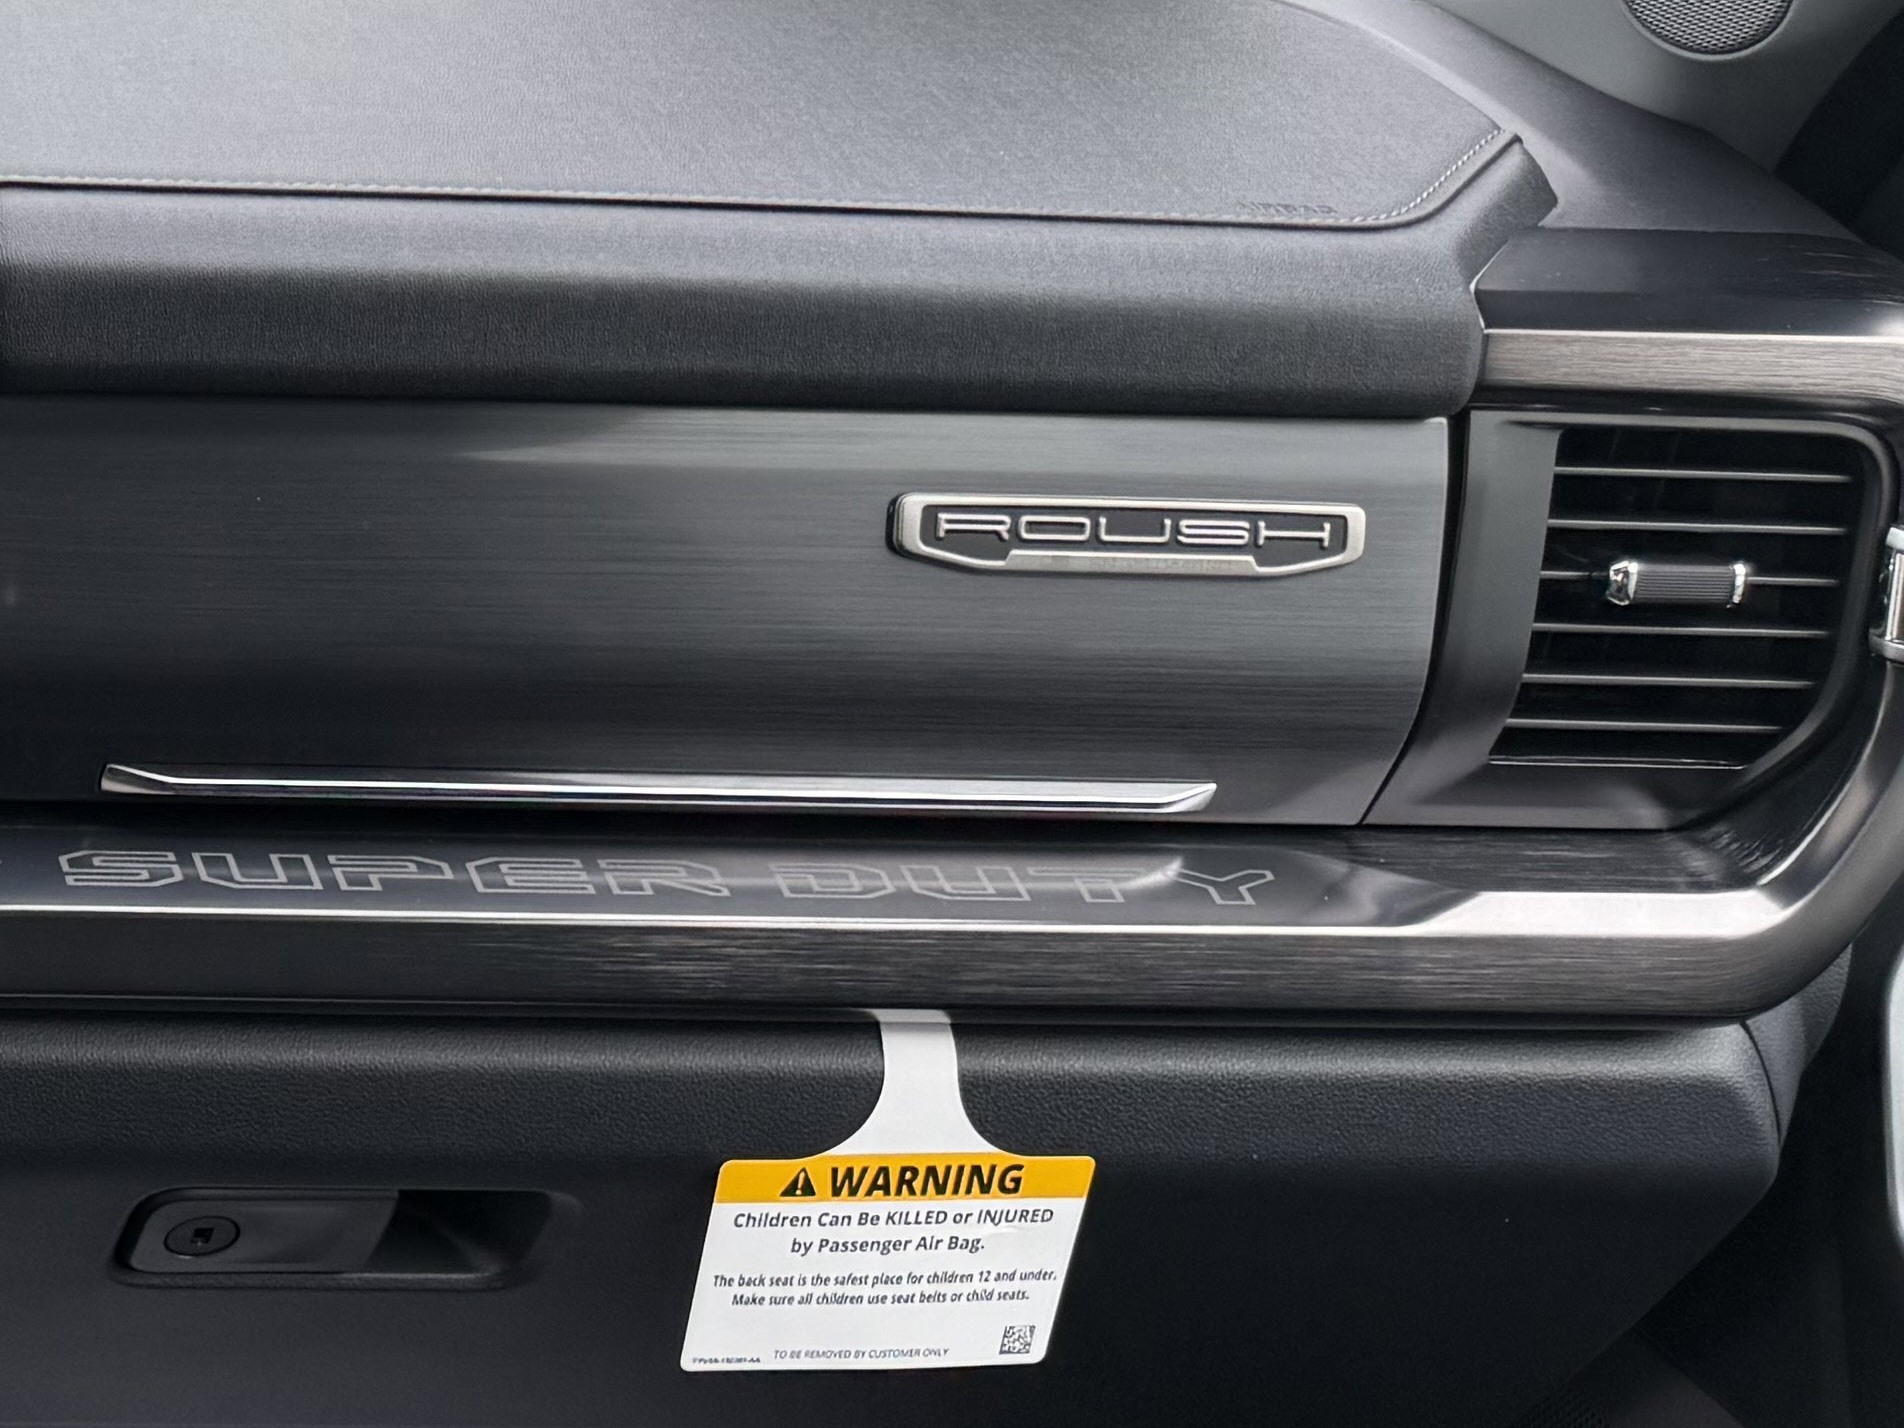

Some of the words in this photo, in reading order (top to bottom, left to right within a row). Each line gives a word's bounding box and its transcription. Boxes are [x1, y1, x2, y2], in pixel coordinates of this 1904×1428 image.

[936, 512, 1331, 549] ROUSH
[58, 849, 723, 898] SUPER
[773, 862, 1277, 908] DUTY
[829, 1163, 1025, 1198] WARNING
[734, 1210, 812, 1229] Children
[817, 1211, 852, 1228] Can
[857, 1211, 880, 1227] Be
[885, 1209, 948, 1226] KILLED
[953, 1211, 974, 1225] or
[977, 1207, 1055, 1226] INJURED
[791, 1237, 813, 1257] by
[818, 1236, 912, 1257] Passenger
[915, 1235, 944, 1251] Air
[947, 1235, 986, 1254] Bag.
[713, 1274, 734, 1287] The
[738, 1273, 765, 1287] back
[769, 1274, 794, 1287] seat
[797, 1273, 807, 1287] is
[810, 1273, 831, 1286] the
[833, 1272, 869, 1287] safest
[871, 1271, 903, 1288] place
[906, 1271, 924, 1285] for
[927, 1270, 974, 1284] children
[978, 1270, 992, 1282] 12
[994, 1269, 1016, 1282] and
[1019, 1268, 1057, 1282] under.
[732, 1293, 765, 1306] Make
[768, 1294, 794, 1306] sure
[797, 1292, 813, 1305] all
[816, 1292, 864, 1305] children
[867, 1294, 888, 1305] use
[891, 1292, 915, 1304] seat
[919, 1290, 947, 1304] belts
[950, 1292, 963, 1302] or
[966, 1288, 994, 1302] child
[997, 1289, 1030, 1301] seats.
[774, 1349, 788, 1360] TO
[804, 1348, 852, 1359] REMOVED
[868, 1348, 921, 1359] CUSTOMER
[922, 1347, 950, 1358] ONLY
